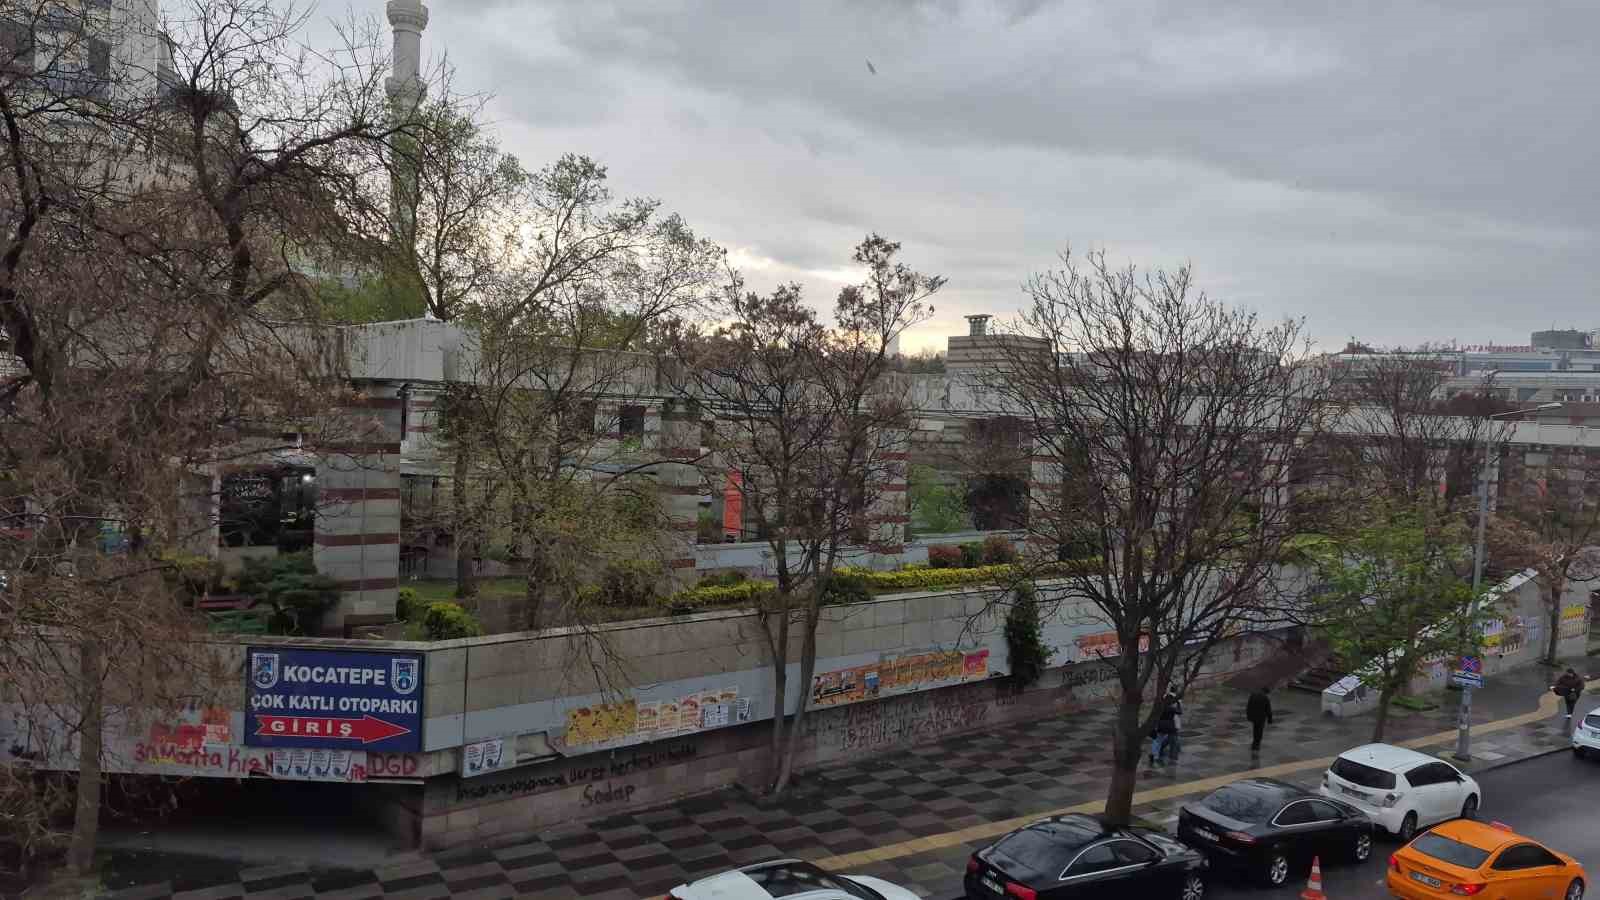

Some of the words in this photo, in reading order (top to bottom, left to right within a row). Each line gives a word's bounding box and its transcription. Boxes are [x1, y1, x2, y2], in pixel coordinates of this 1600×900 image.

[283, 665, 386, 686] KOCATEPE
[250, 694, 284, 711] ÇOK
[288, 695, 335, 711] KATLI
[338, 697, 418, 715] OTOPARKI
[270, 719, 353, 737] GİRİŞ
